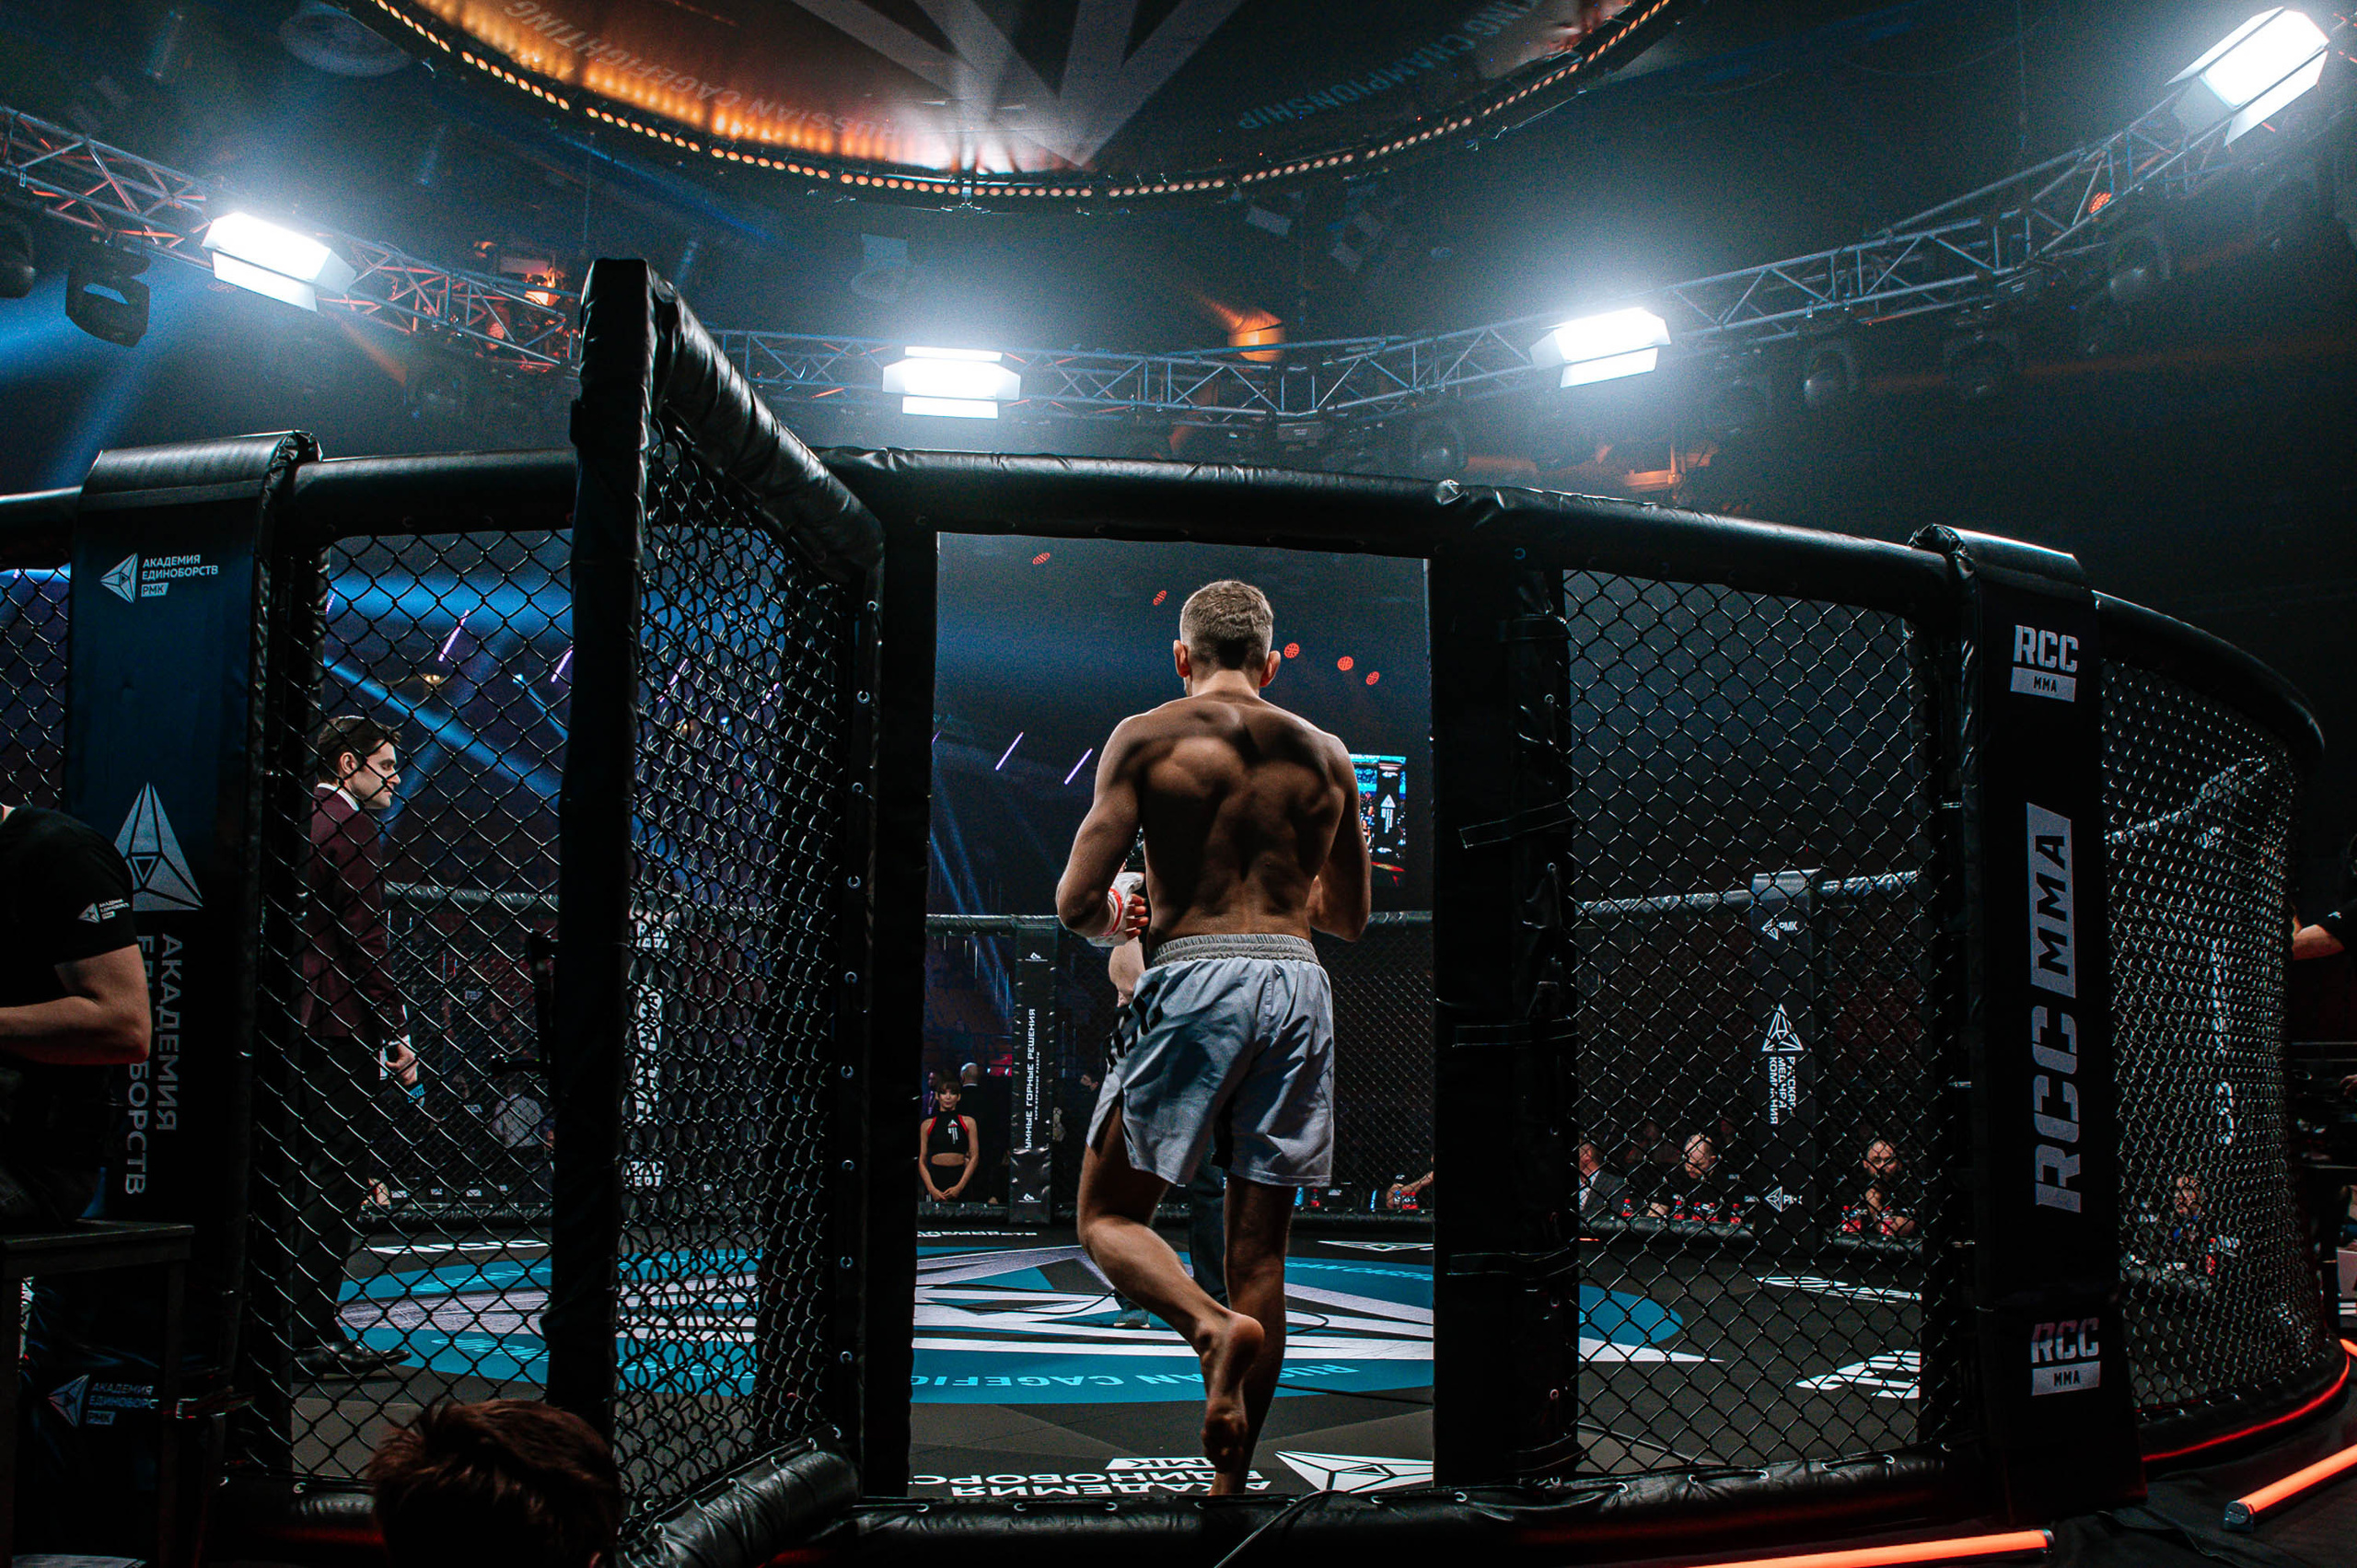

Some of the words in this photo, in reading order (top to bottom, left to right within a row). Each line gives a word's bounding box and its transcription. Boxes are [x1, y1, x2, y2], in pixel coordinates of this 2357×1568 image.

[504, 1, 742, 108] CAGEFIGHTING
[1237, 34, 1476, 130] CHAMPIONSHIP
[142, 565, 218, 581] ЕДИНОБОРСТВ
[143, 554, 201, 568] АКАДЕМИЯ
[143, 584, 165, 596] РМК
[2013, 624, 2079, 673] RCC
[2033, 676, 2058, 692] MMA
[2035, 834, 2069, 977] MMA
[155, 933, 184, 1131] АКАДЕМИЯ
[1027, 1008, 1036, 1060] РЕШЕНИЯ
[124, 935, 155, 1194] ЕБОРСТВ
[1025, 1063, 1035, 1107] ГОРНЫЕ
[1024, 1110, 1033, 1149] УМНЫЕ
[2031, 1005, 2082, 1214] RCC
[2030, 1317, 2100, 1364] RCC
[2053, 1370, 2081, 1387] MMA
